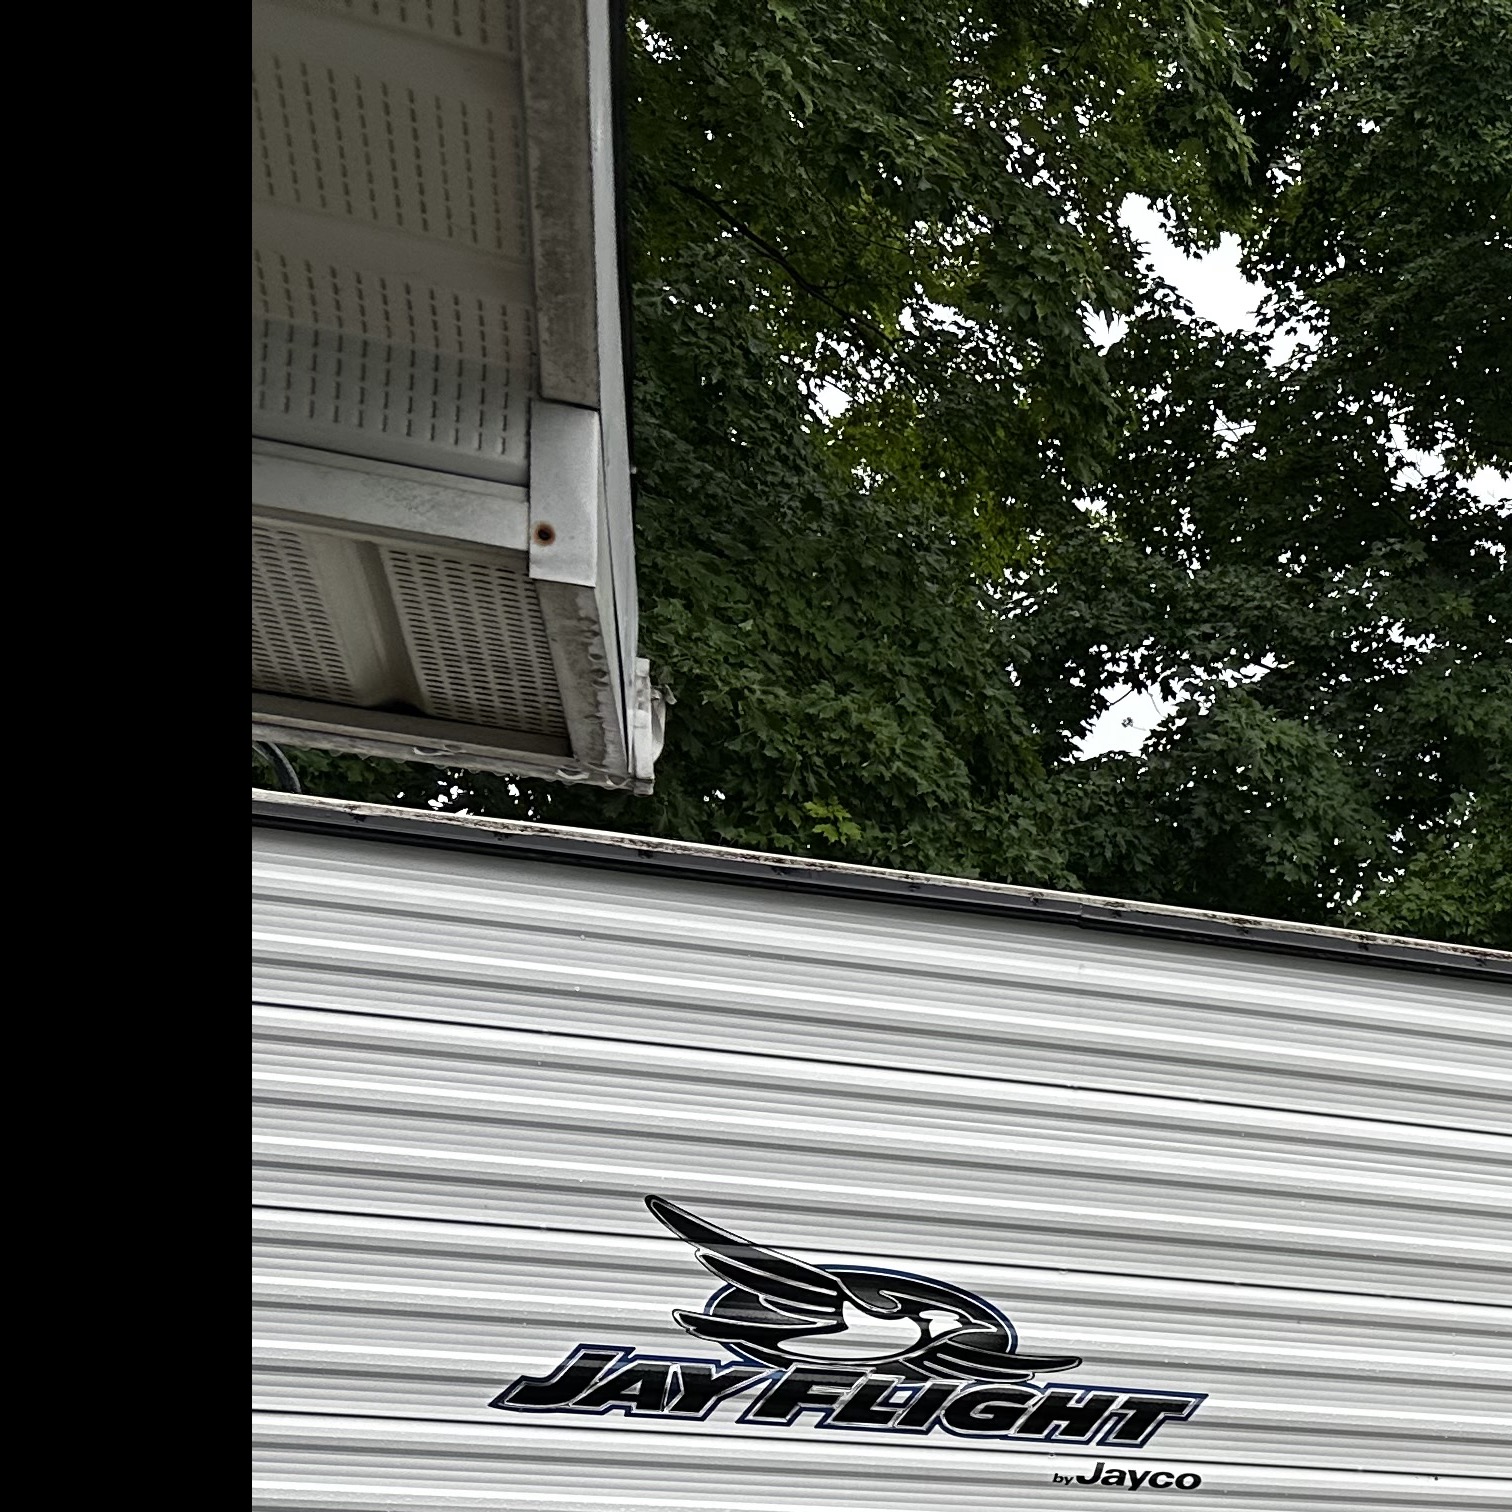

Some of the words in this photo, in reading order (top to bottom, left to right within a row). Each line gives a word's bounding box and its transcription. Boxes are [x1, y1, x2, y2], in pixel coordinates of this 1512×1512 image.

[489, 1344, 757, 1420] JAY
[737, 1366, 1209, 1447] FLIGHT
[1052, 1471, 1074, 1487] by
[1075, 1462, 1203, 1492] Jayco
